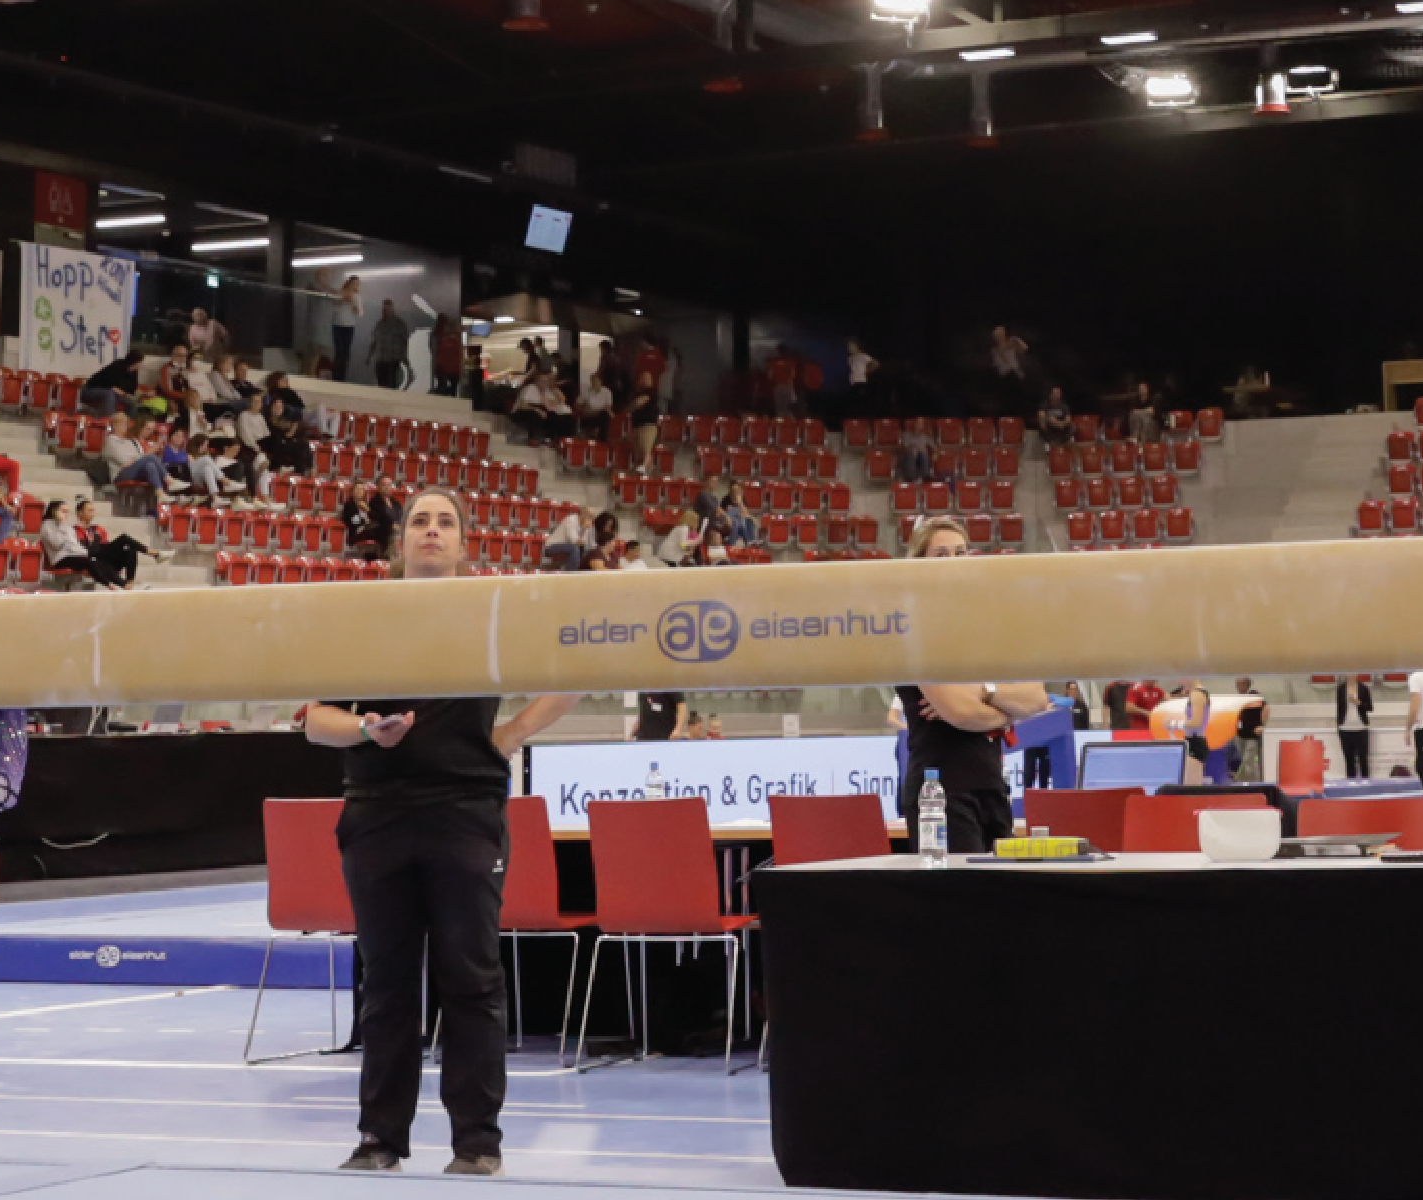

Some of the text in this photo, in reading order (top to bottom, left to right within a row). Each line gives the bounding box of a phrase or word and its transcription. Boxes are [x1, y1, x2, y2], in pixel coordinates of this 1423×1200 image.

[35, 244, 95, 302] Hopp
[560, 778, 712, 816] Konzetion
[721, 775, 739, 806] &
